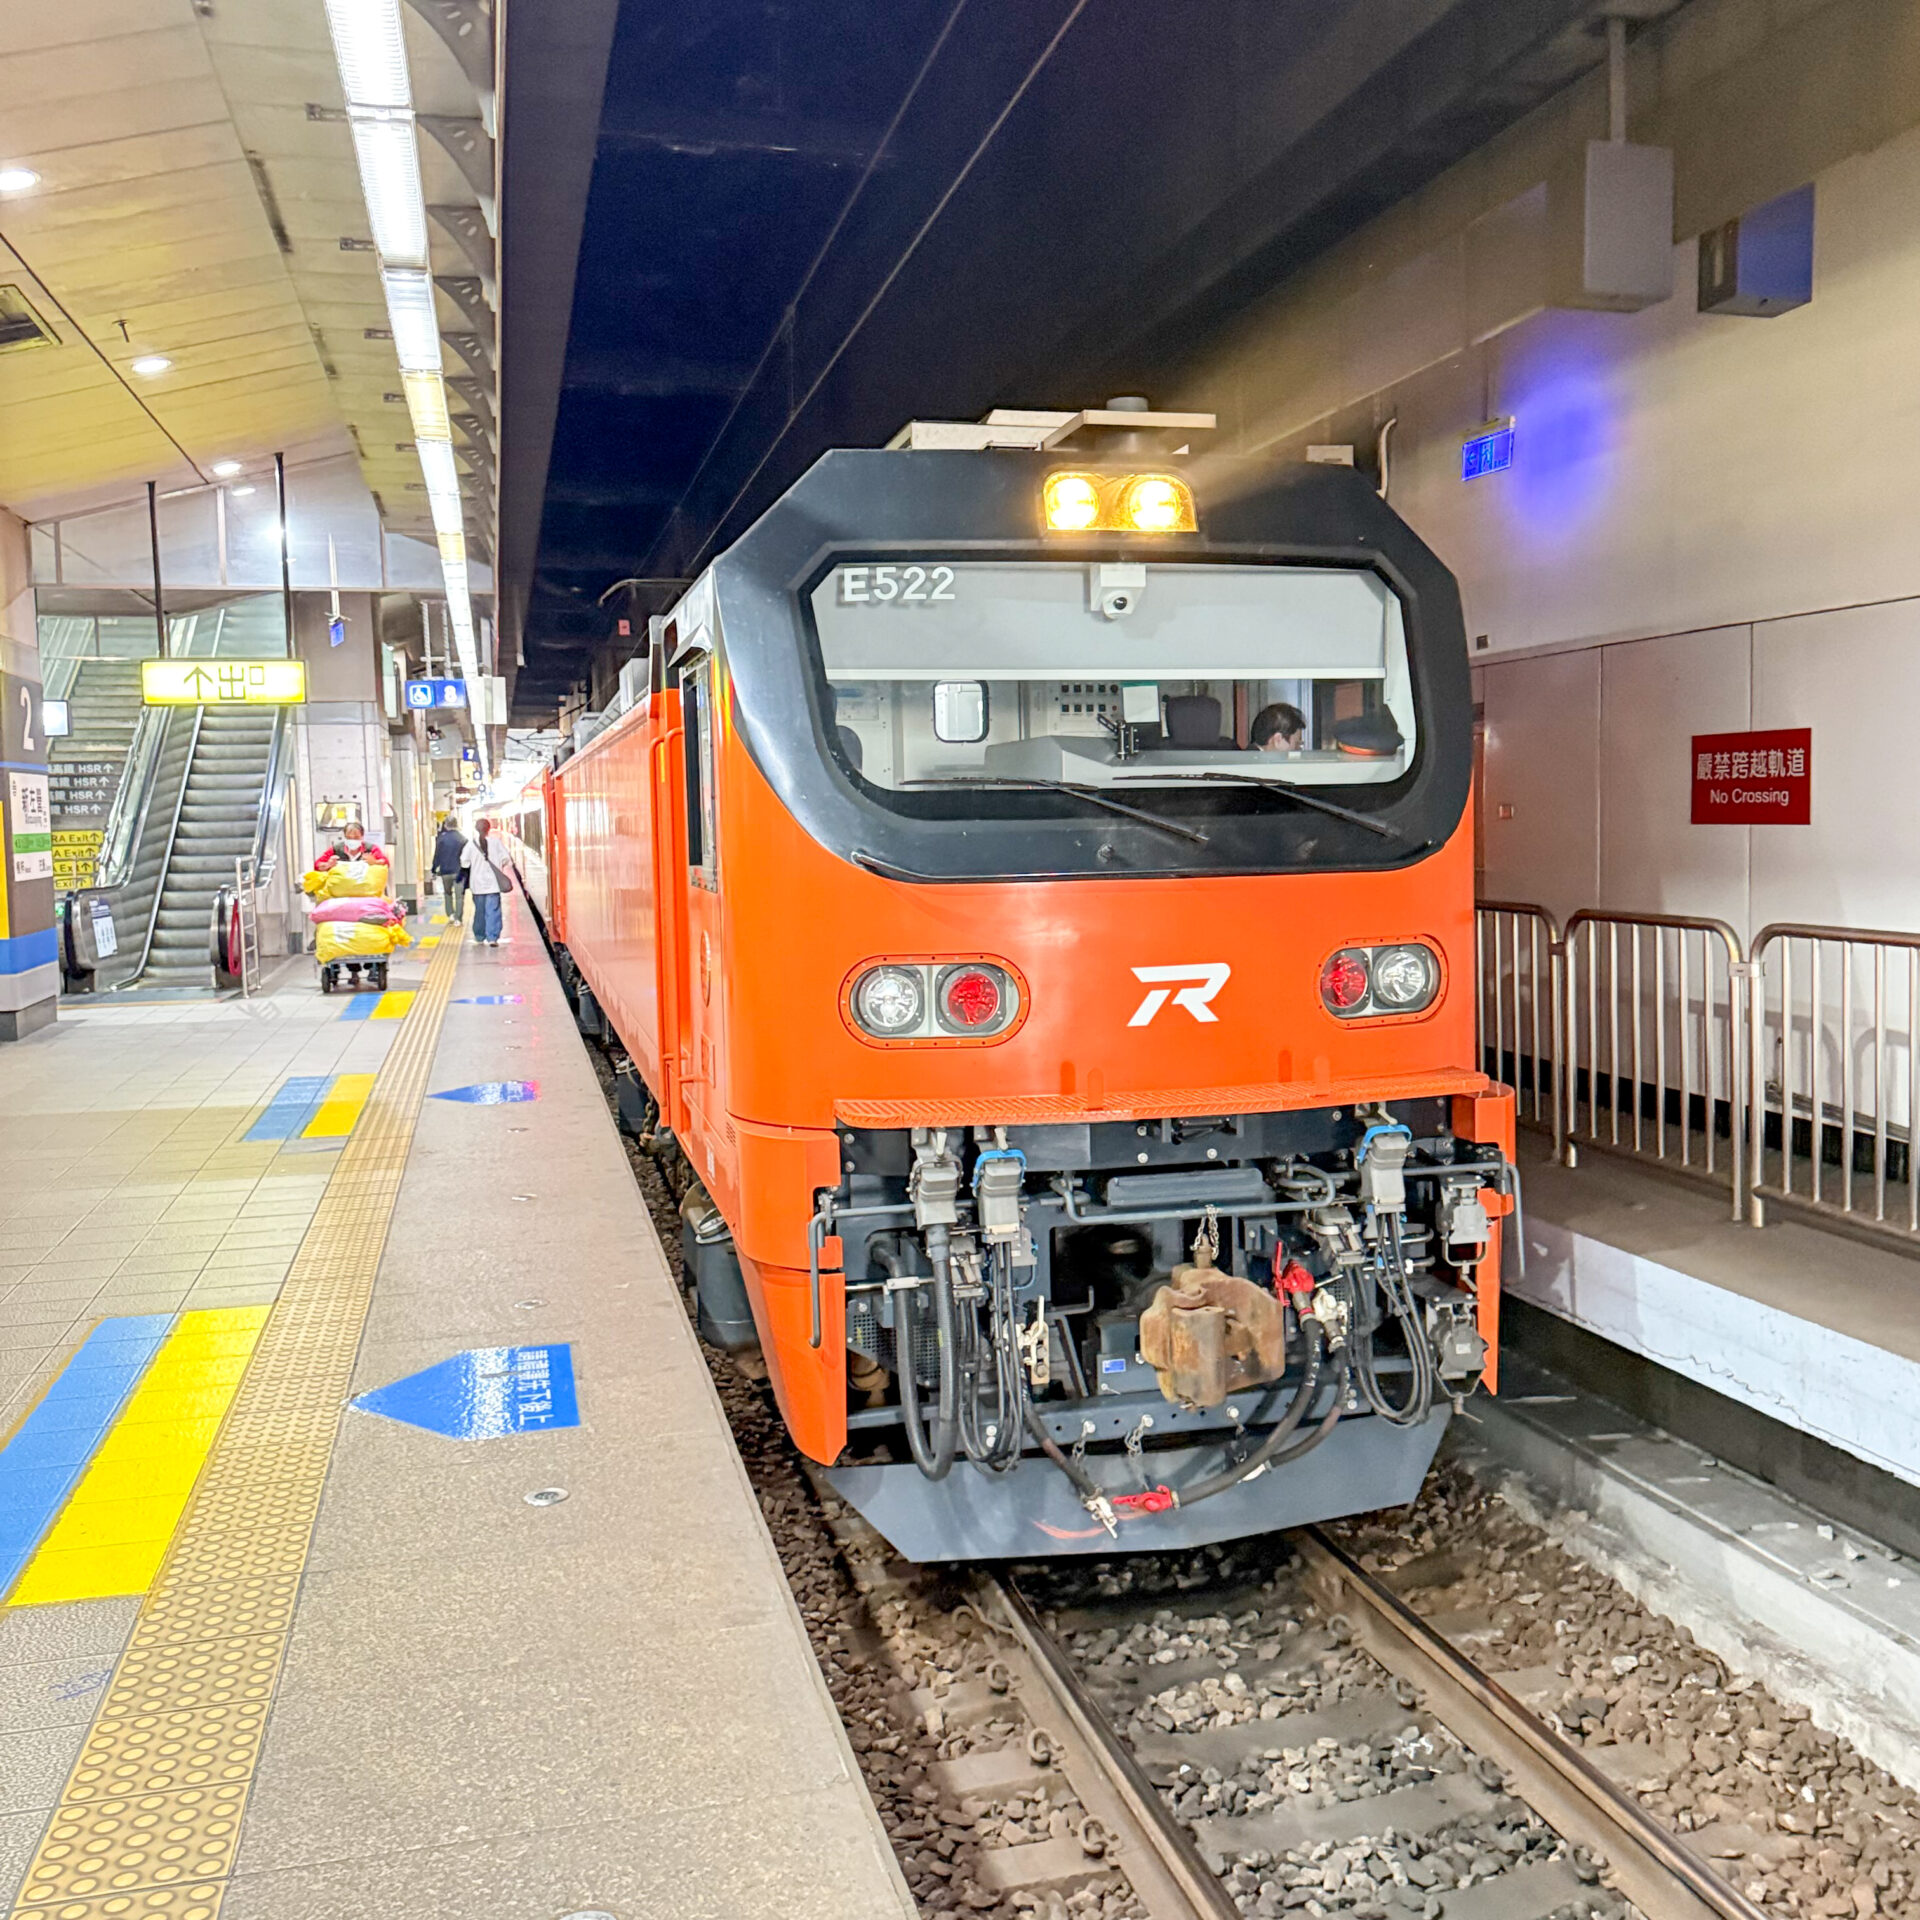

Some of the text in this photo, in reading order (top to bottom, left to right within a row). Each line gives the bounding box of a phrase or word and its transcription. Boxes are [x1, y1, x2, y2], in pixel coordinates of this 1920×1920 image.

[843, 566, 956, 602] E522
[218, 665, 265, 700] 出口
[443, 684, 458, 703] 8
[20, 685, 35, 751] 2
[78, 763, 102, 774] HSR
[1696, 748, 1806, 781] 嚴禁跨越軌道
[73, 777, 98, 787] HSR
[69, 790, 94, 800] HSR
[1709, 787, 1790, 806] No Crossing
[64, 804, 89, 815] HSR
[69, 834, 89, 843] Exit
[64, 849, 84, 858] Exit
